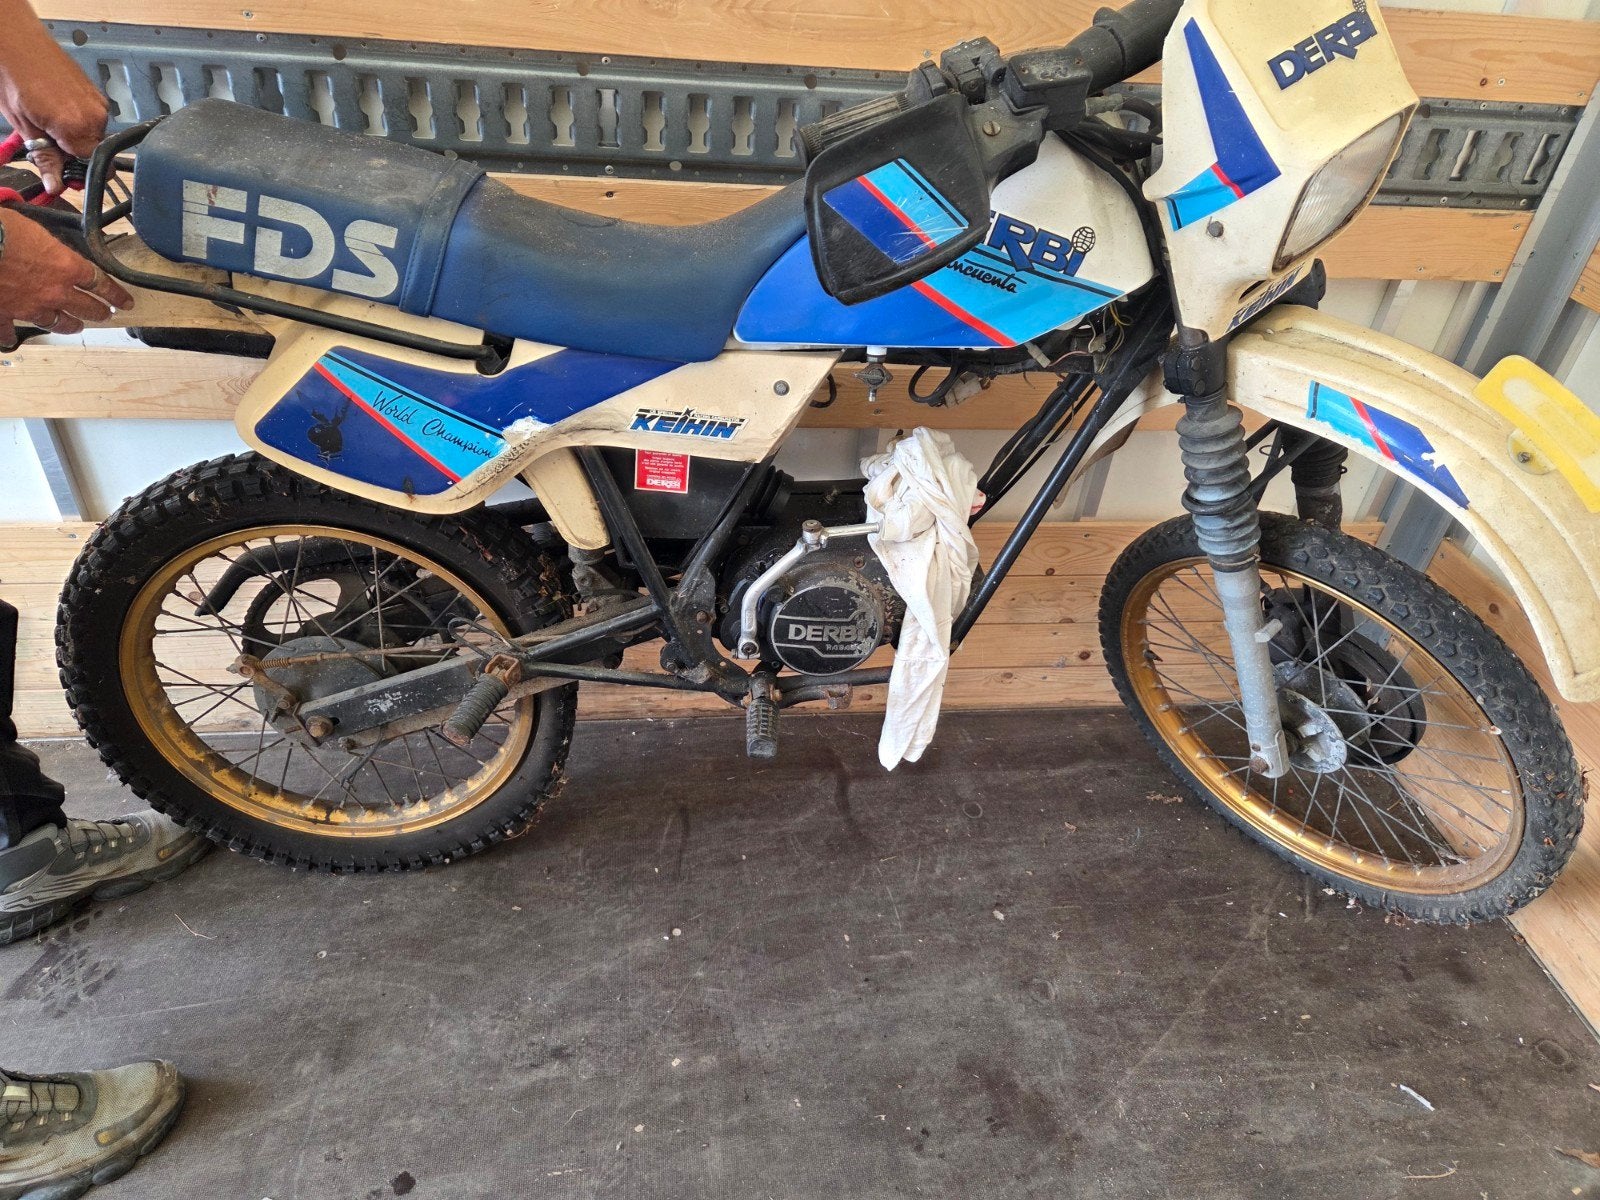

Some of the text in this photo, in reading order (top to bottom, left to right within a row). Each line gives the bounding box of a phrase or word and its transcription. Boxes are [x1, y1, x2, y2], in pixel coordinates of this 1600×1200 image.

[182, 179, 399, 298] FDS
[372, 390, 495, 459] World Champion
[629, 410, 743, 439] KEIHIN
